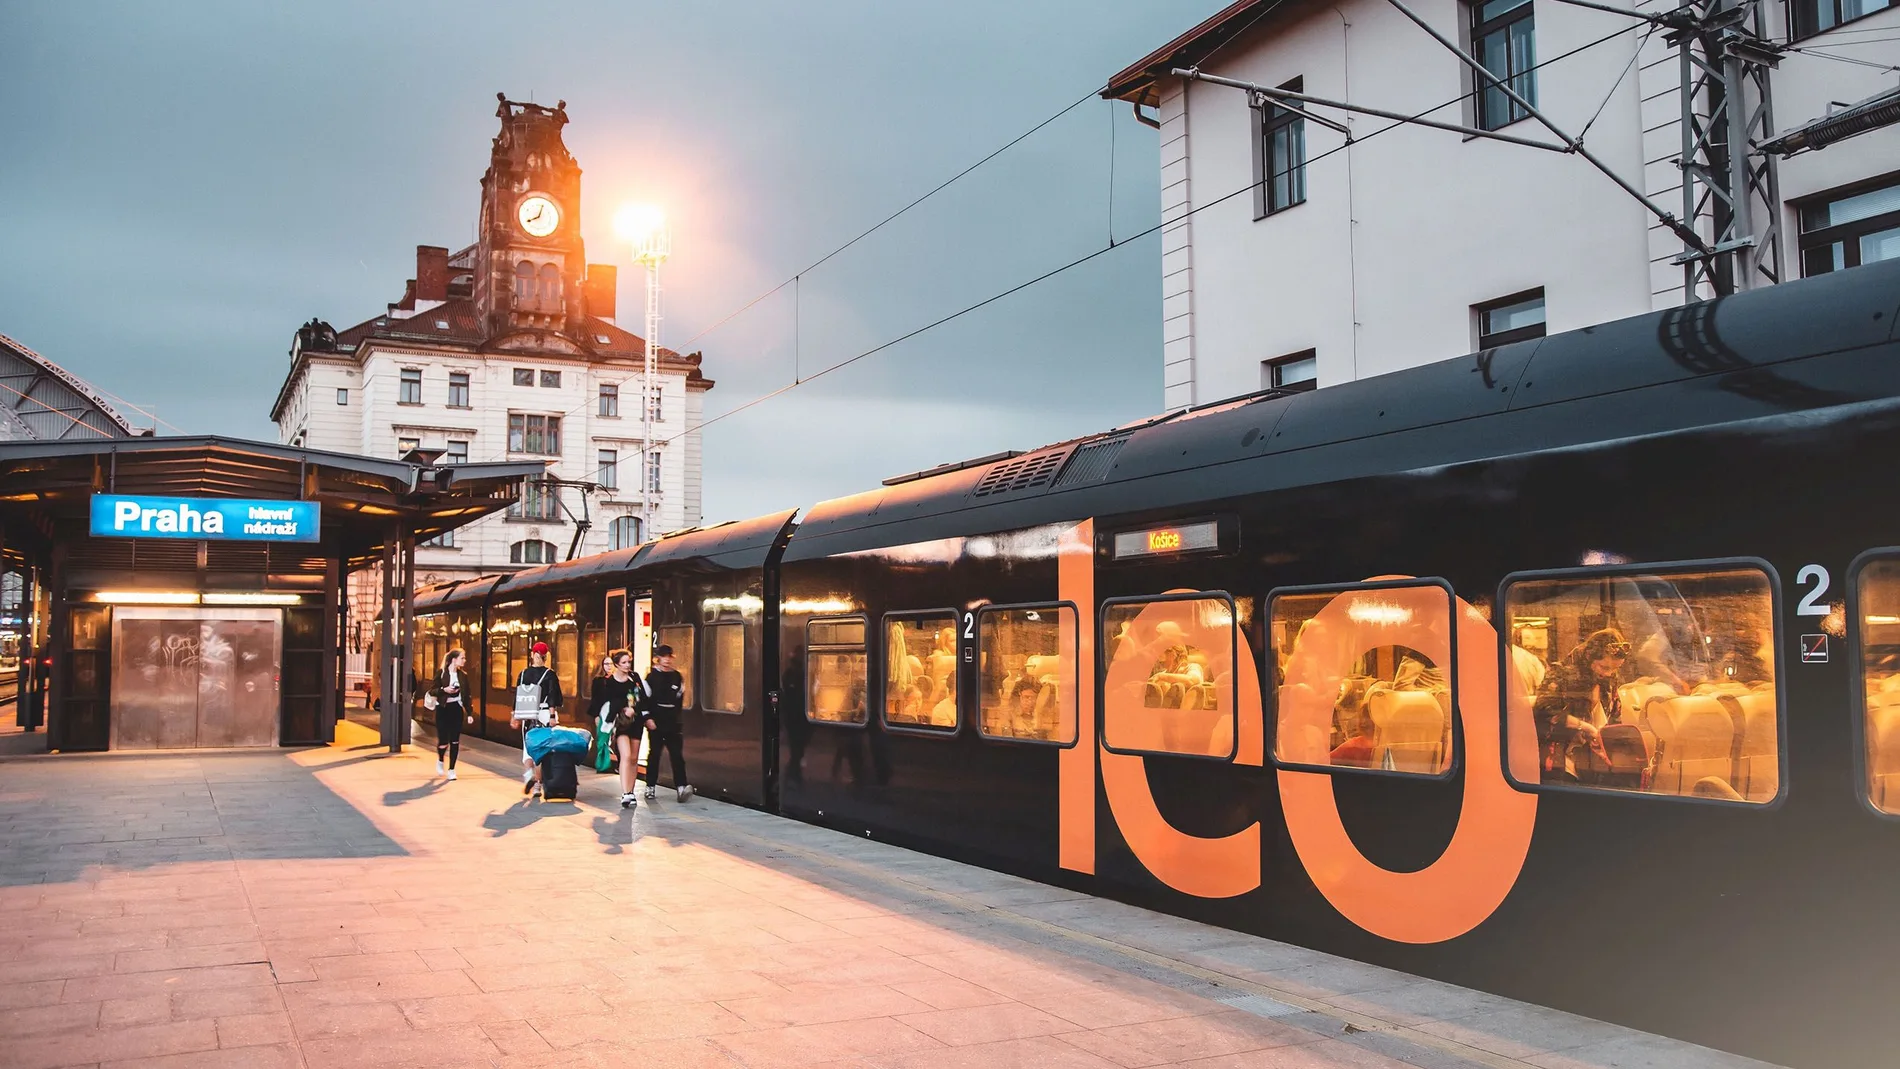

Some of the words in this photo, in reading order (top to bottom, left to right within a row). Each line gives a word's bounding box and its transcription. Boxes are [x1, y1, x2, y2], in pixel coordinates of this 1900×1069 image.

[114, 501, 224, 534] Praha
[243, 521, 298, 535] nádraží
[1149, 531, 1180, 550] Košice
[1796, 563, 1831, 616] 2
[963, 612, 974, 639] 2
[652, 631, 658, 648] 2
[1058, 517, 1541, 945] leo
